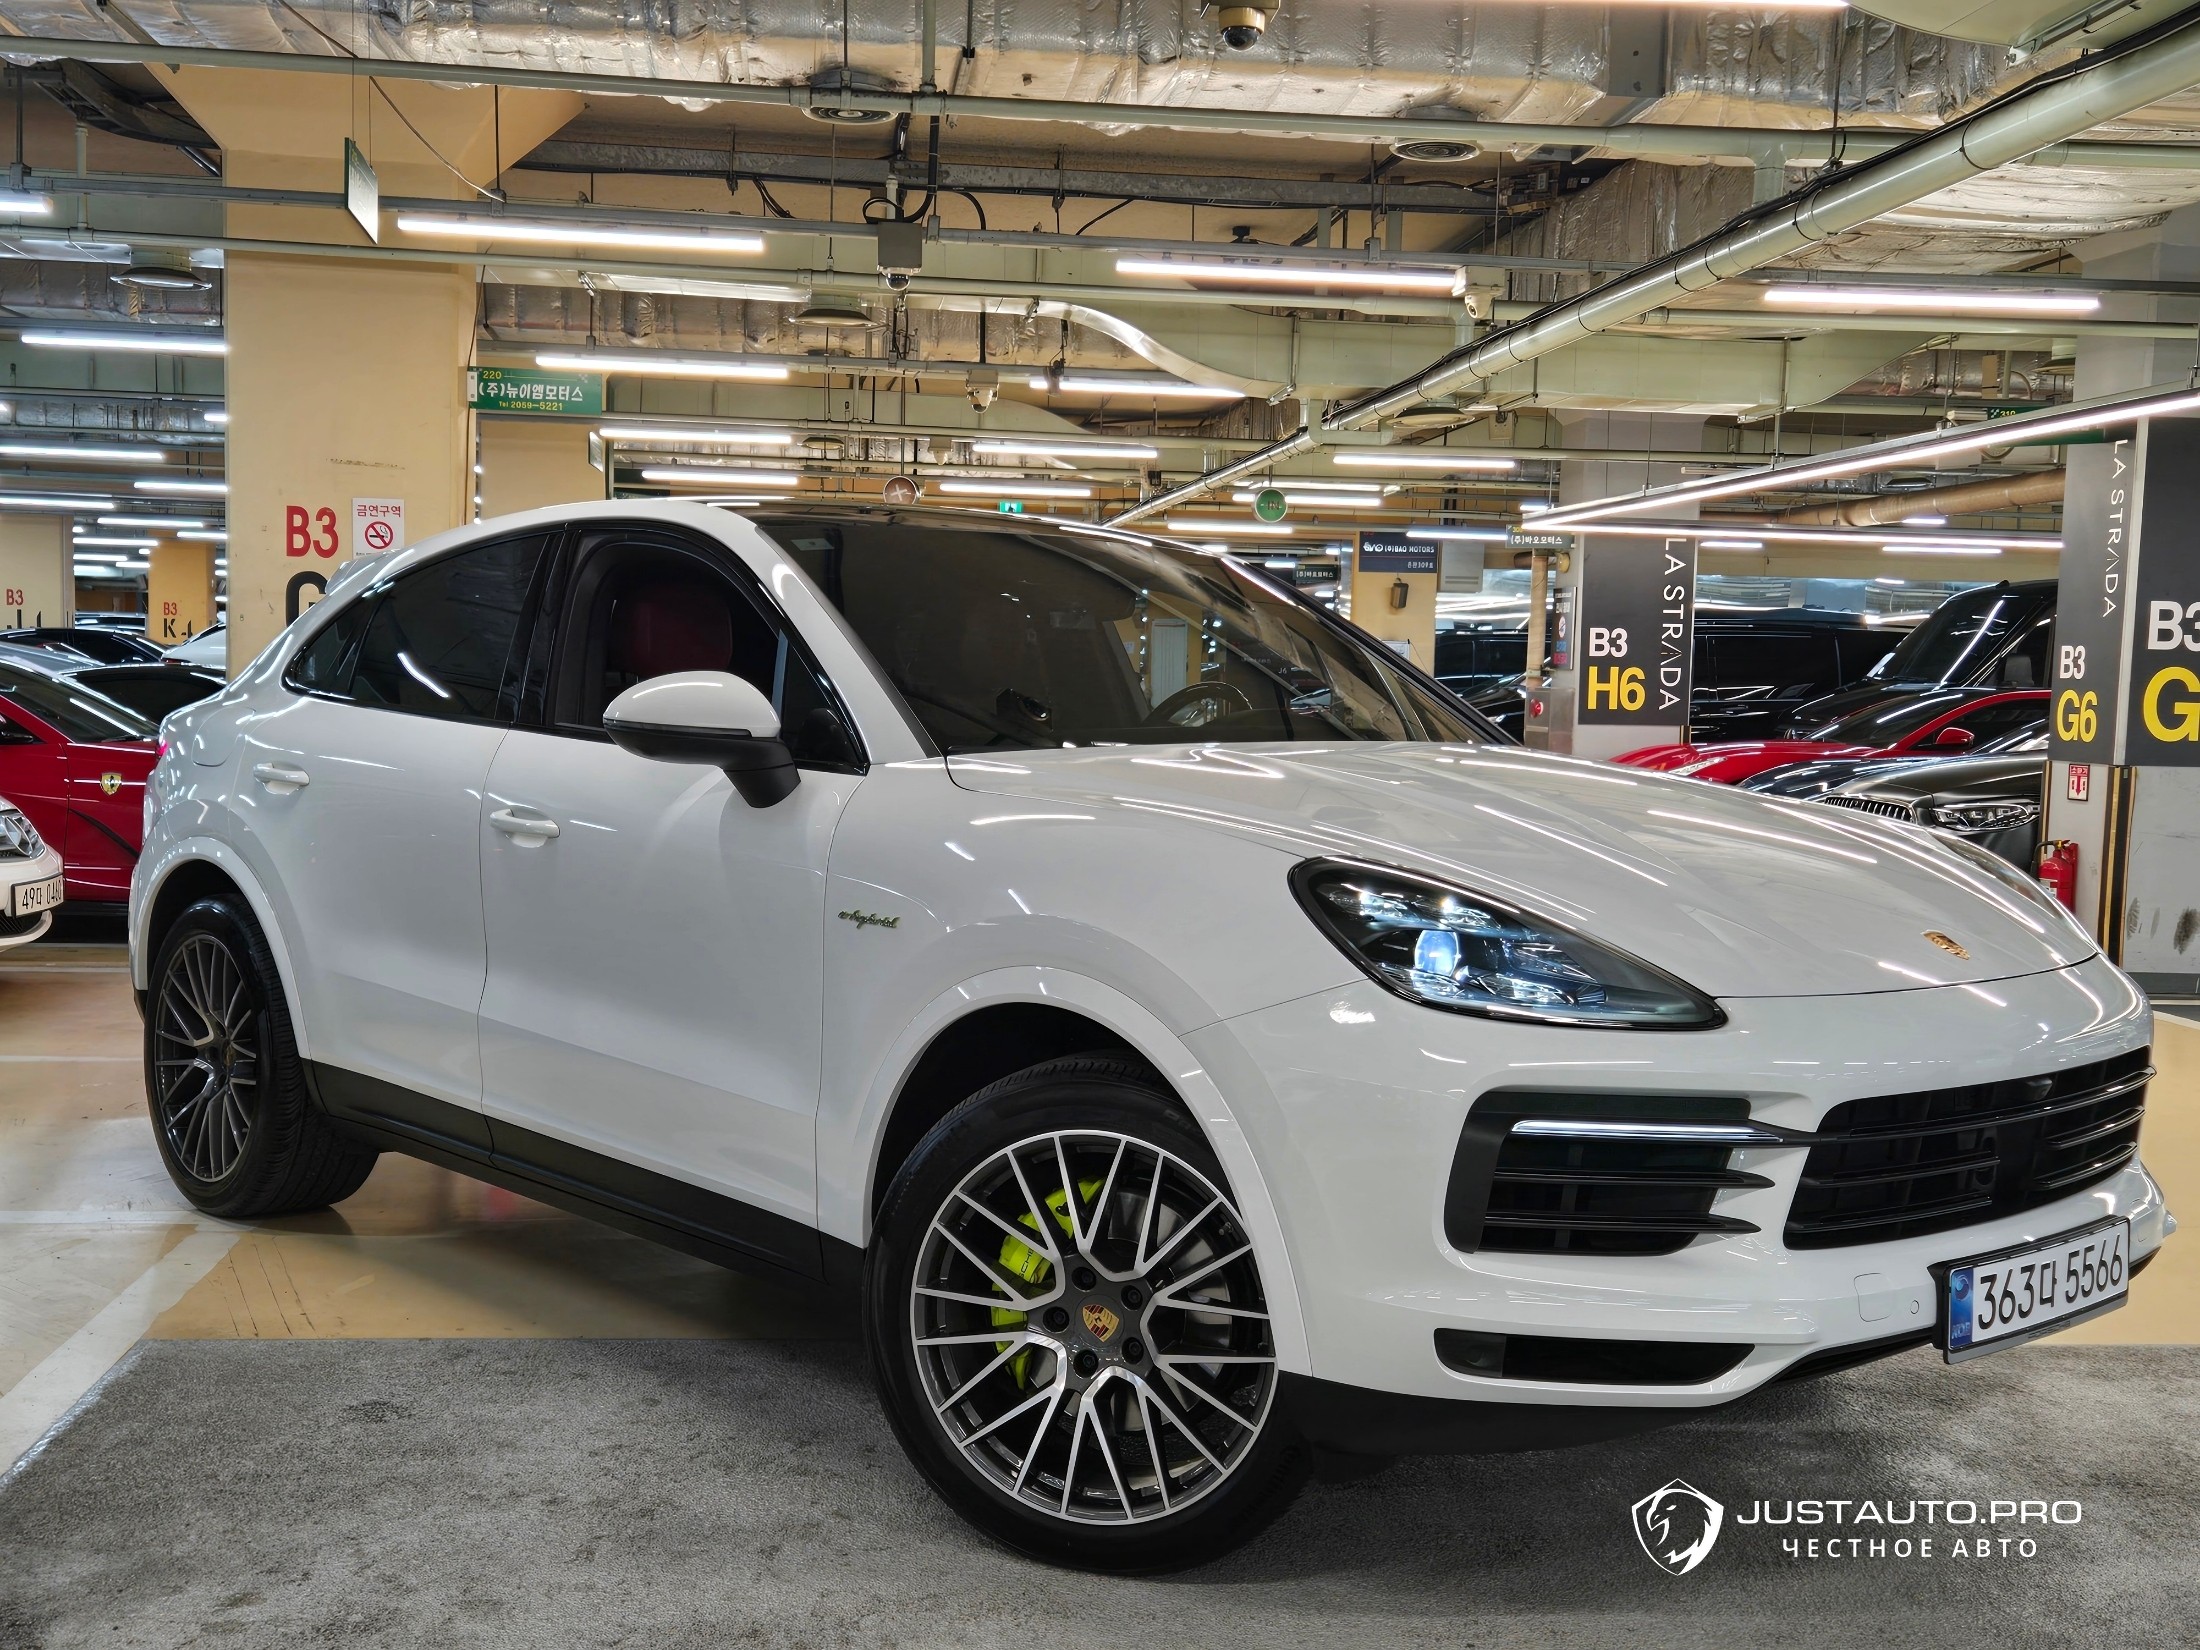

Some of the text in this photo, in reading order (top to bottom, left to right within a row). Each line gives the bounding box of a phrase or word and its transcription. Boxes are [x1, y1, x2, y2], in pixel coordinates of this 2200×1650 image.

[483, 370, 502, 380] 220
[356, 504, 401, 518] 금연구역
[286, 505, 339, 558] B3
[2102, 488, 2125, 618] STRADA
[6, 588, 24, 606] B3
[163, 601, 178, 616] B3
[1588, 627, 1629, 658] B3
[1658, 537, 1687, 711] LA STRADA
[2059, 645, 2086, 680] B3
[1587, 665, 1646, 711] H6
[2056, 689, 2099, 743] G6
[2065, 1233, 2123, 1303] 5566
